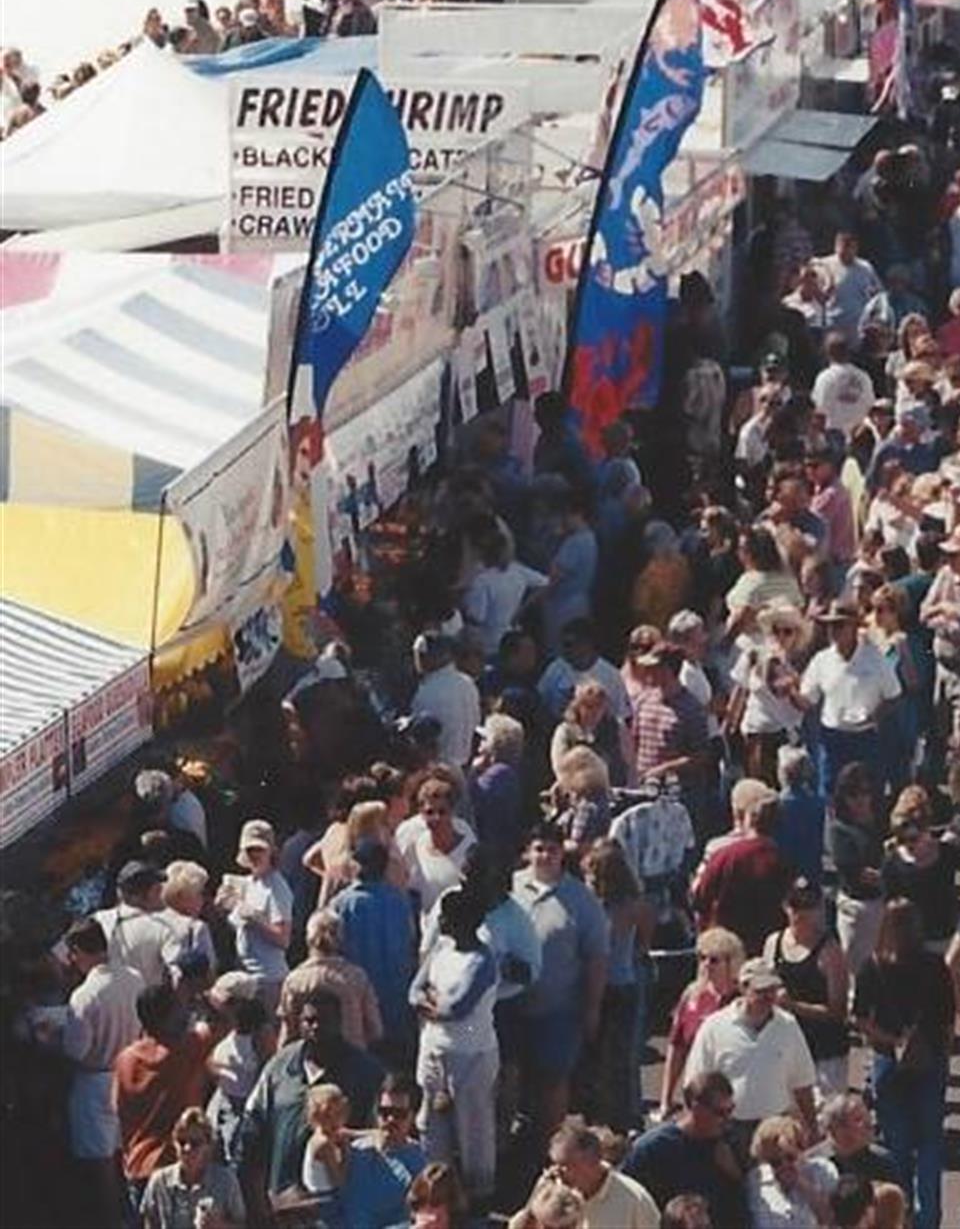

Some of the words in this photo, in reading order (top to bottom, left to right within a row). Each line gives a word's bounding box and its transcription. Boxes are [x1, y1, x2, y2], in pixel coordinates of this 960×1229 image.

[237, 87, 346, 128] FRIED
[385, 89, 504, 133] HRIMP
[242, 146, 329, 168] BLACK
[408, 148, 461, 170] CAT
[240, 185, 314, 209] FRIED
[239, 213, 316, 236] CRAW
